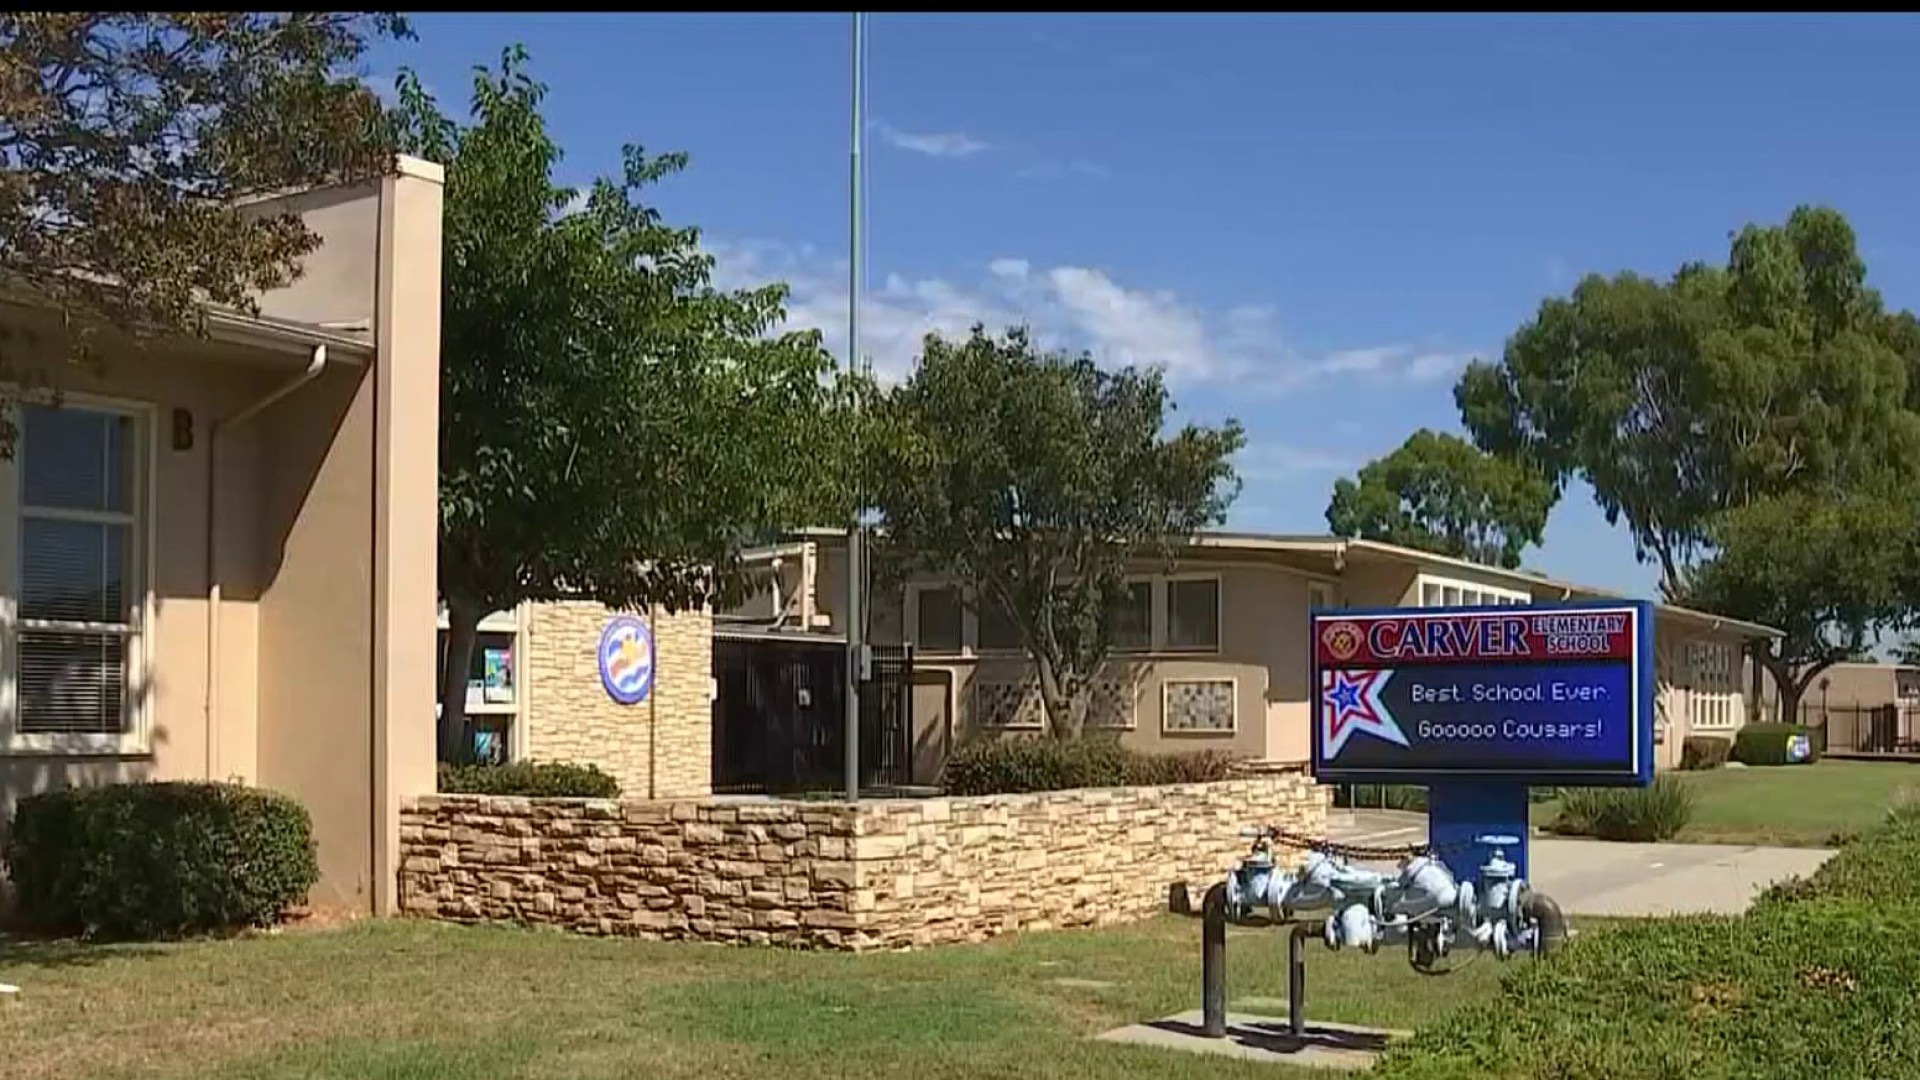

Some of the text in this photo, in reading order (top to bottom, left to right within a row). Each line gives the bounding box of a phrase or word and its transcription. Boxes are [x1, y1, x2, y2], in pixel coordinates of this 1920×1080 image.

[172, 407, 194, 451] B
[1532, 614, 1627, 635] ELEMENTARY
[1367, 616, 1531, 659] CARVER
[1547, 633, 1611, 654] SCHOOL
[1418, 719, 1496, 738] Gooooo
